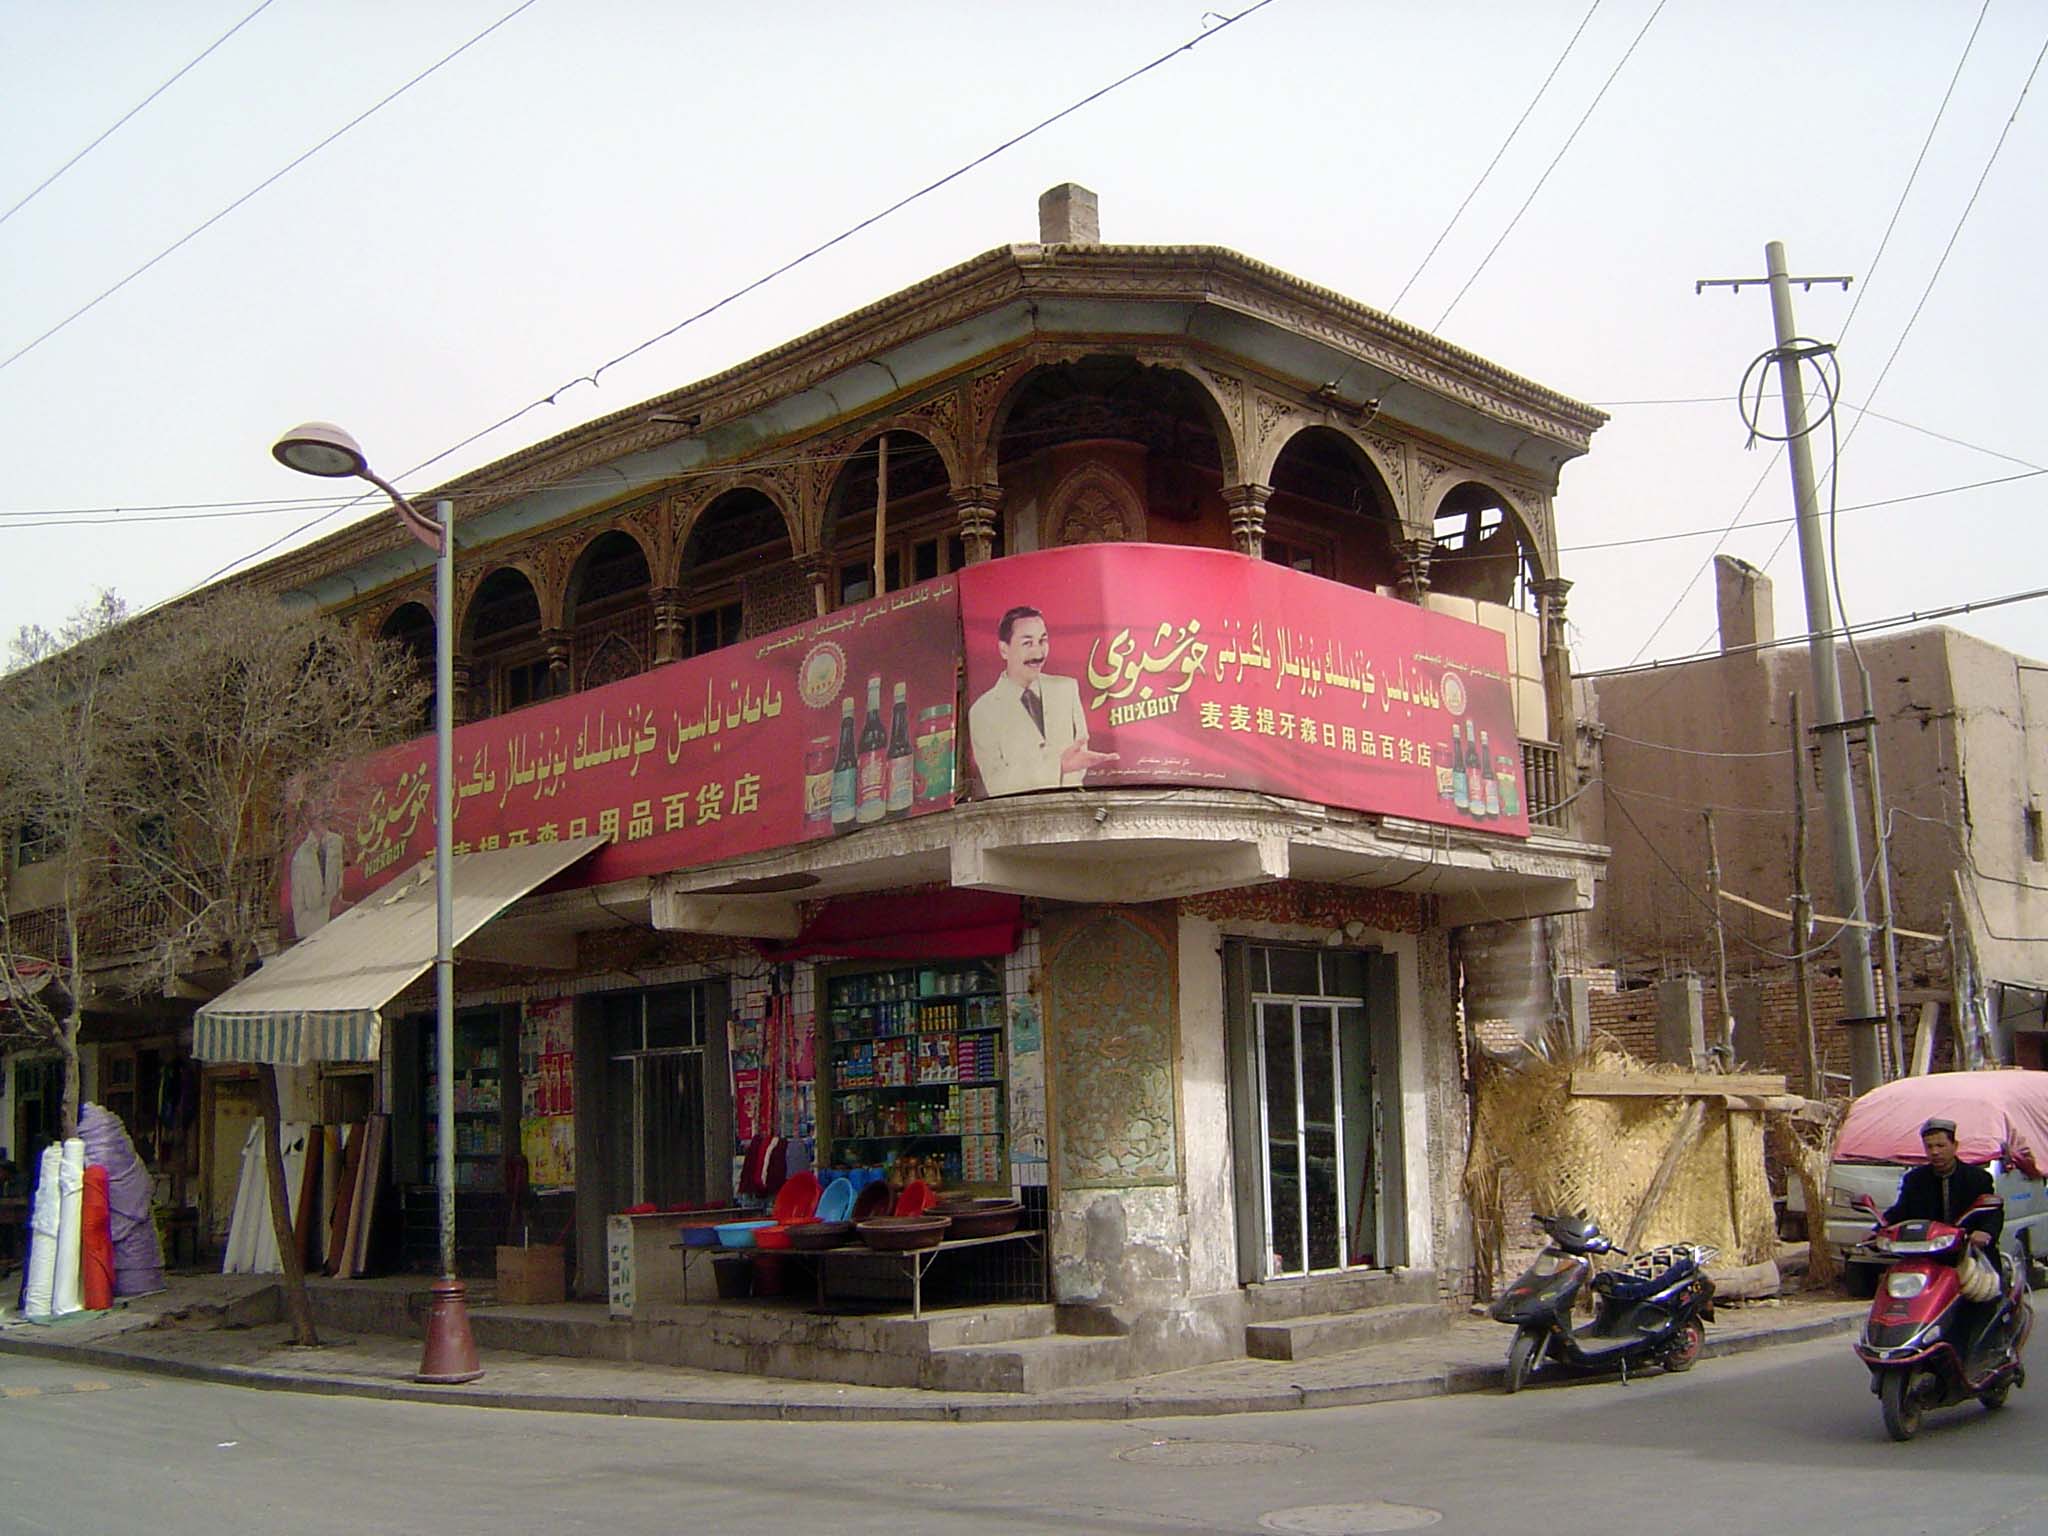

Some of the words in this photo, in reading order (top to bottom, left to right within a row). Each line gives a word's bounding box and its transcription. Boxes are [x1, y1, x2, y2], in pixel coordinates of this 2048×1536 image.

[1199, 701, 1432, 768] 麦麦提牙森日用品百货店
